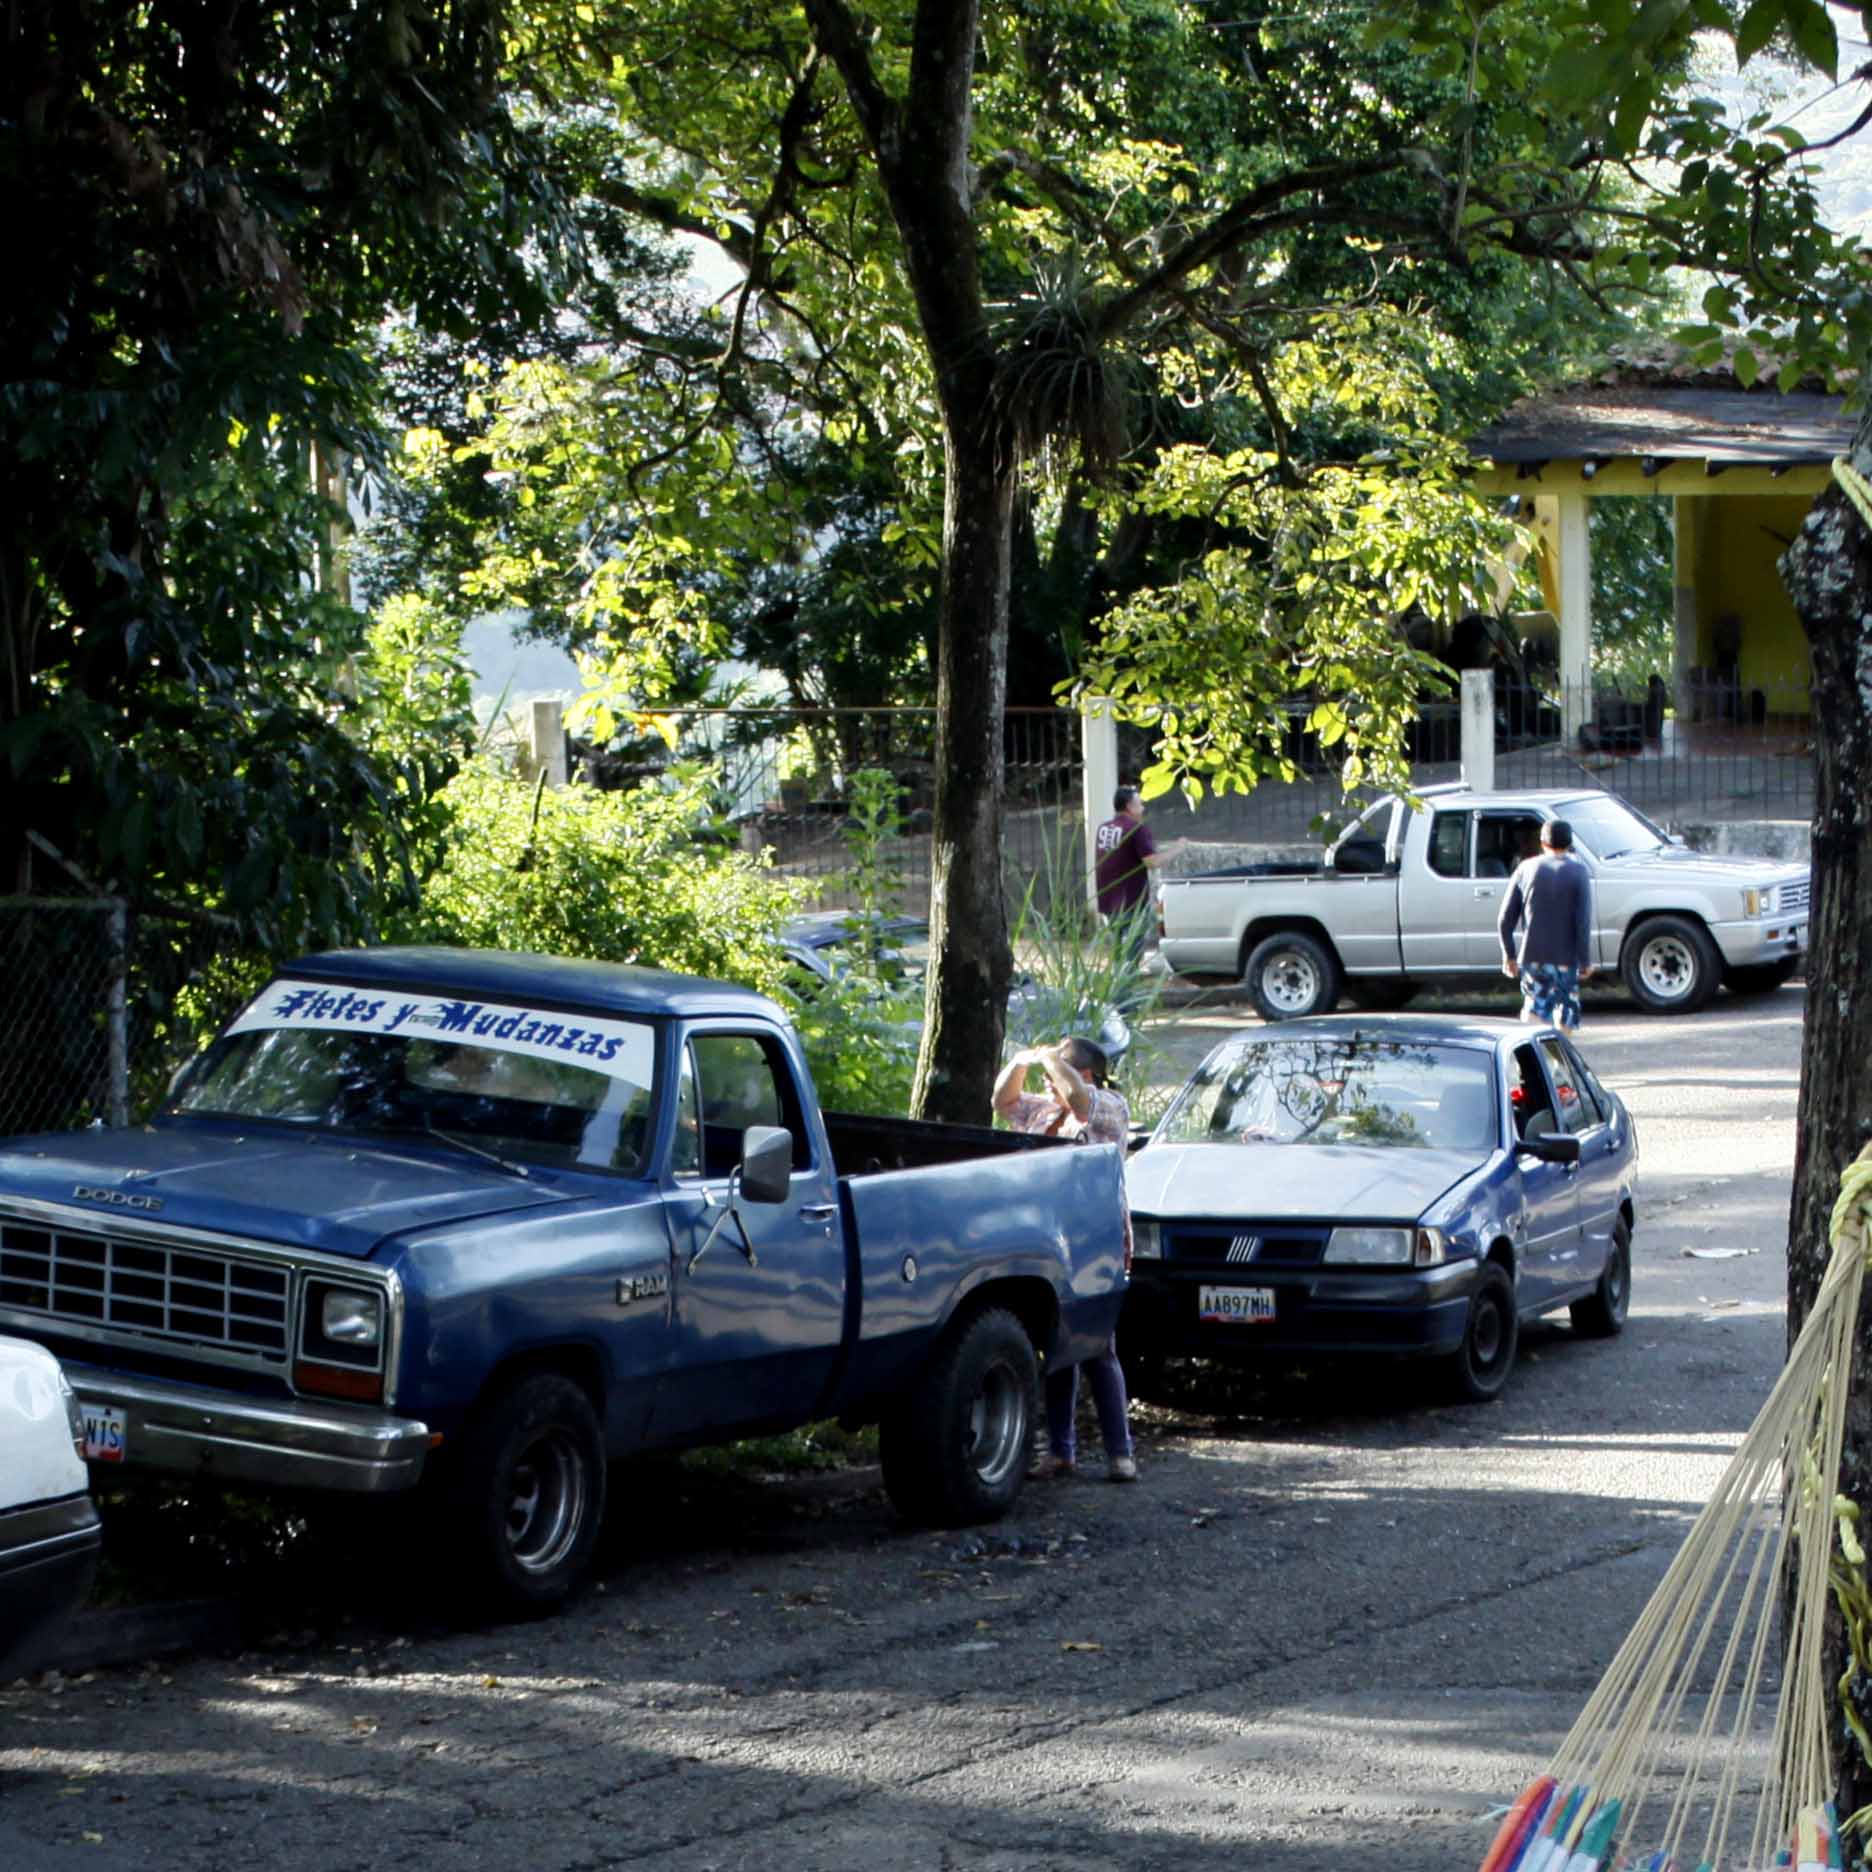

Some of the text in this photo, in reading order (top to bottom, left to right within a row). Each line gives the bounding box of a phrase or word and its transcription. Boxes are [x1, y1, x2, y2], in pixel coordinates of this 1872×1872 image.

[273, 989, 625, 1060] Fletes y Mudanzas
[72, 1185, 164, 1210] DODGE
[635, 1274, 668, 1296] RAM
[87, 1417, 121, 1448] N1S
